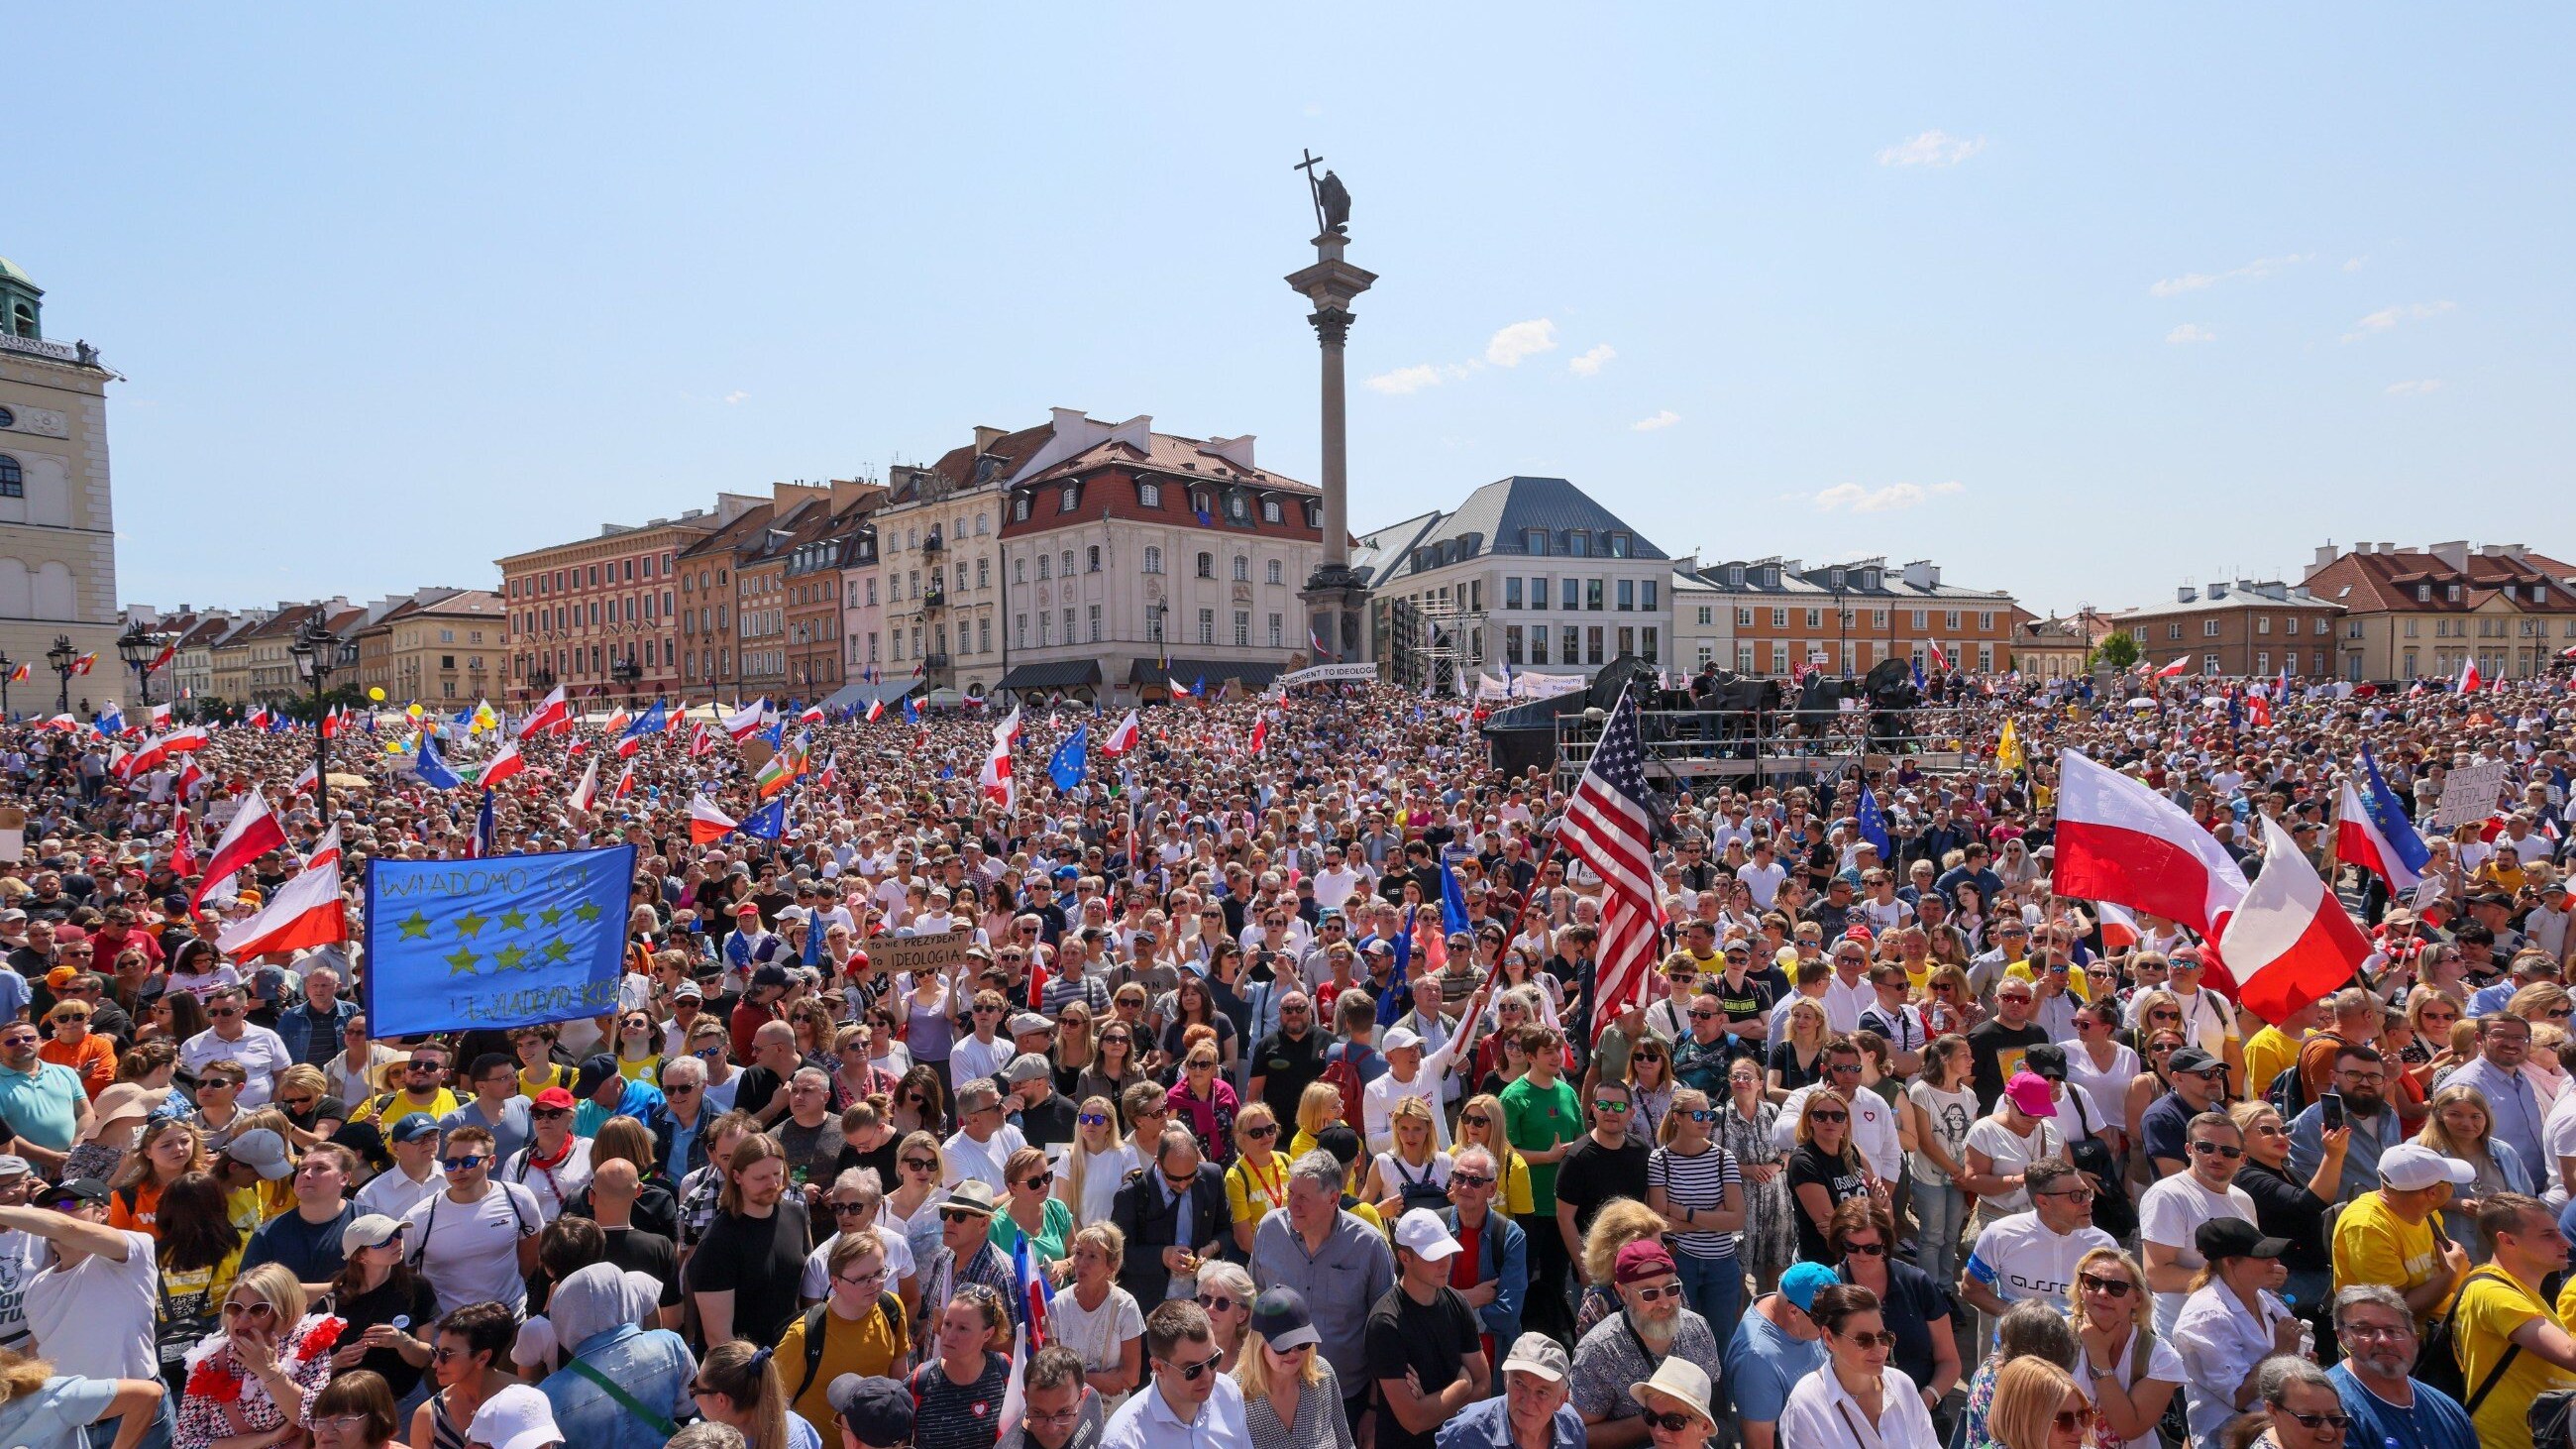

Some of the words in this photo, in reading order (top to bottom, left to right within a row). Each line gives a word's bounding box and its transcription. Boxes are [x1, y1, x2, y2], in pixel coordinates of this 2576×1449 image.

[379, 867, 527, 897] WIADOMO
[903, 933, 963, 947] PREZYDENT
[892, 949, 961, 966] IDEOLOGIA
